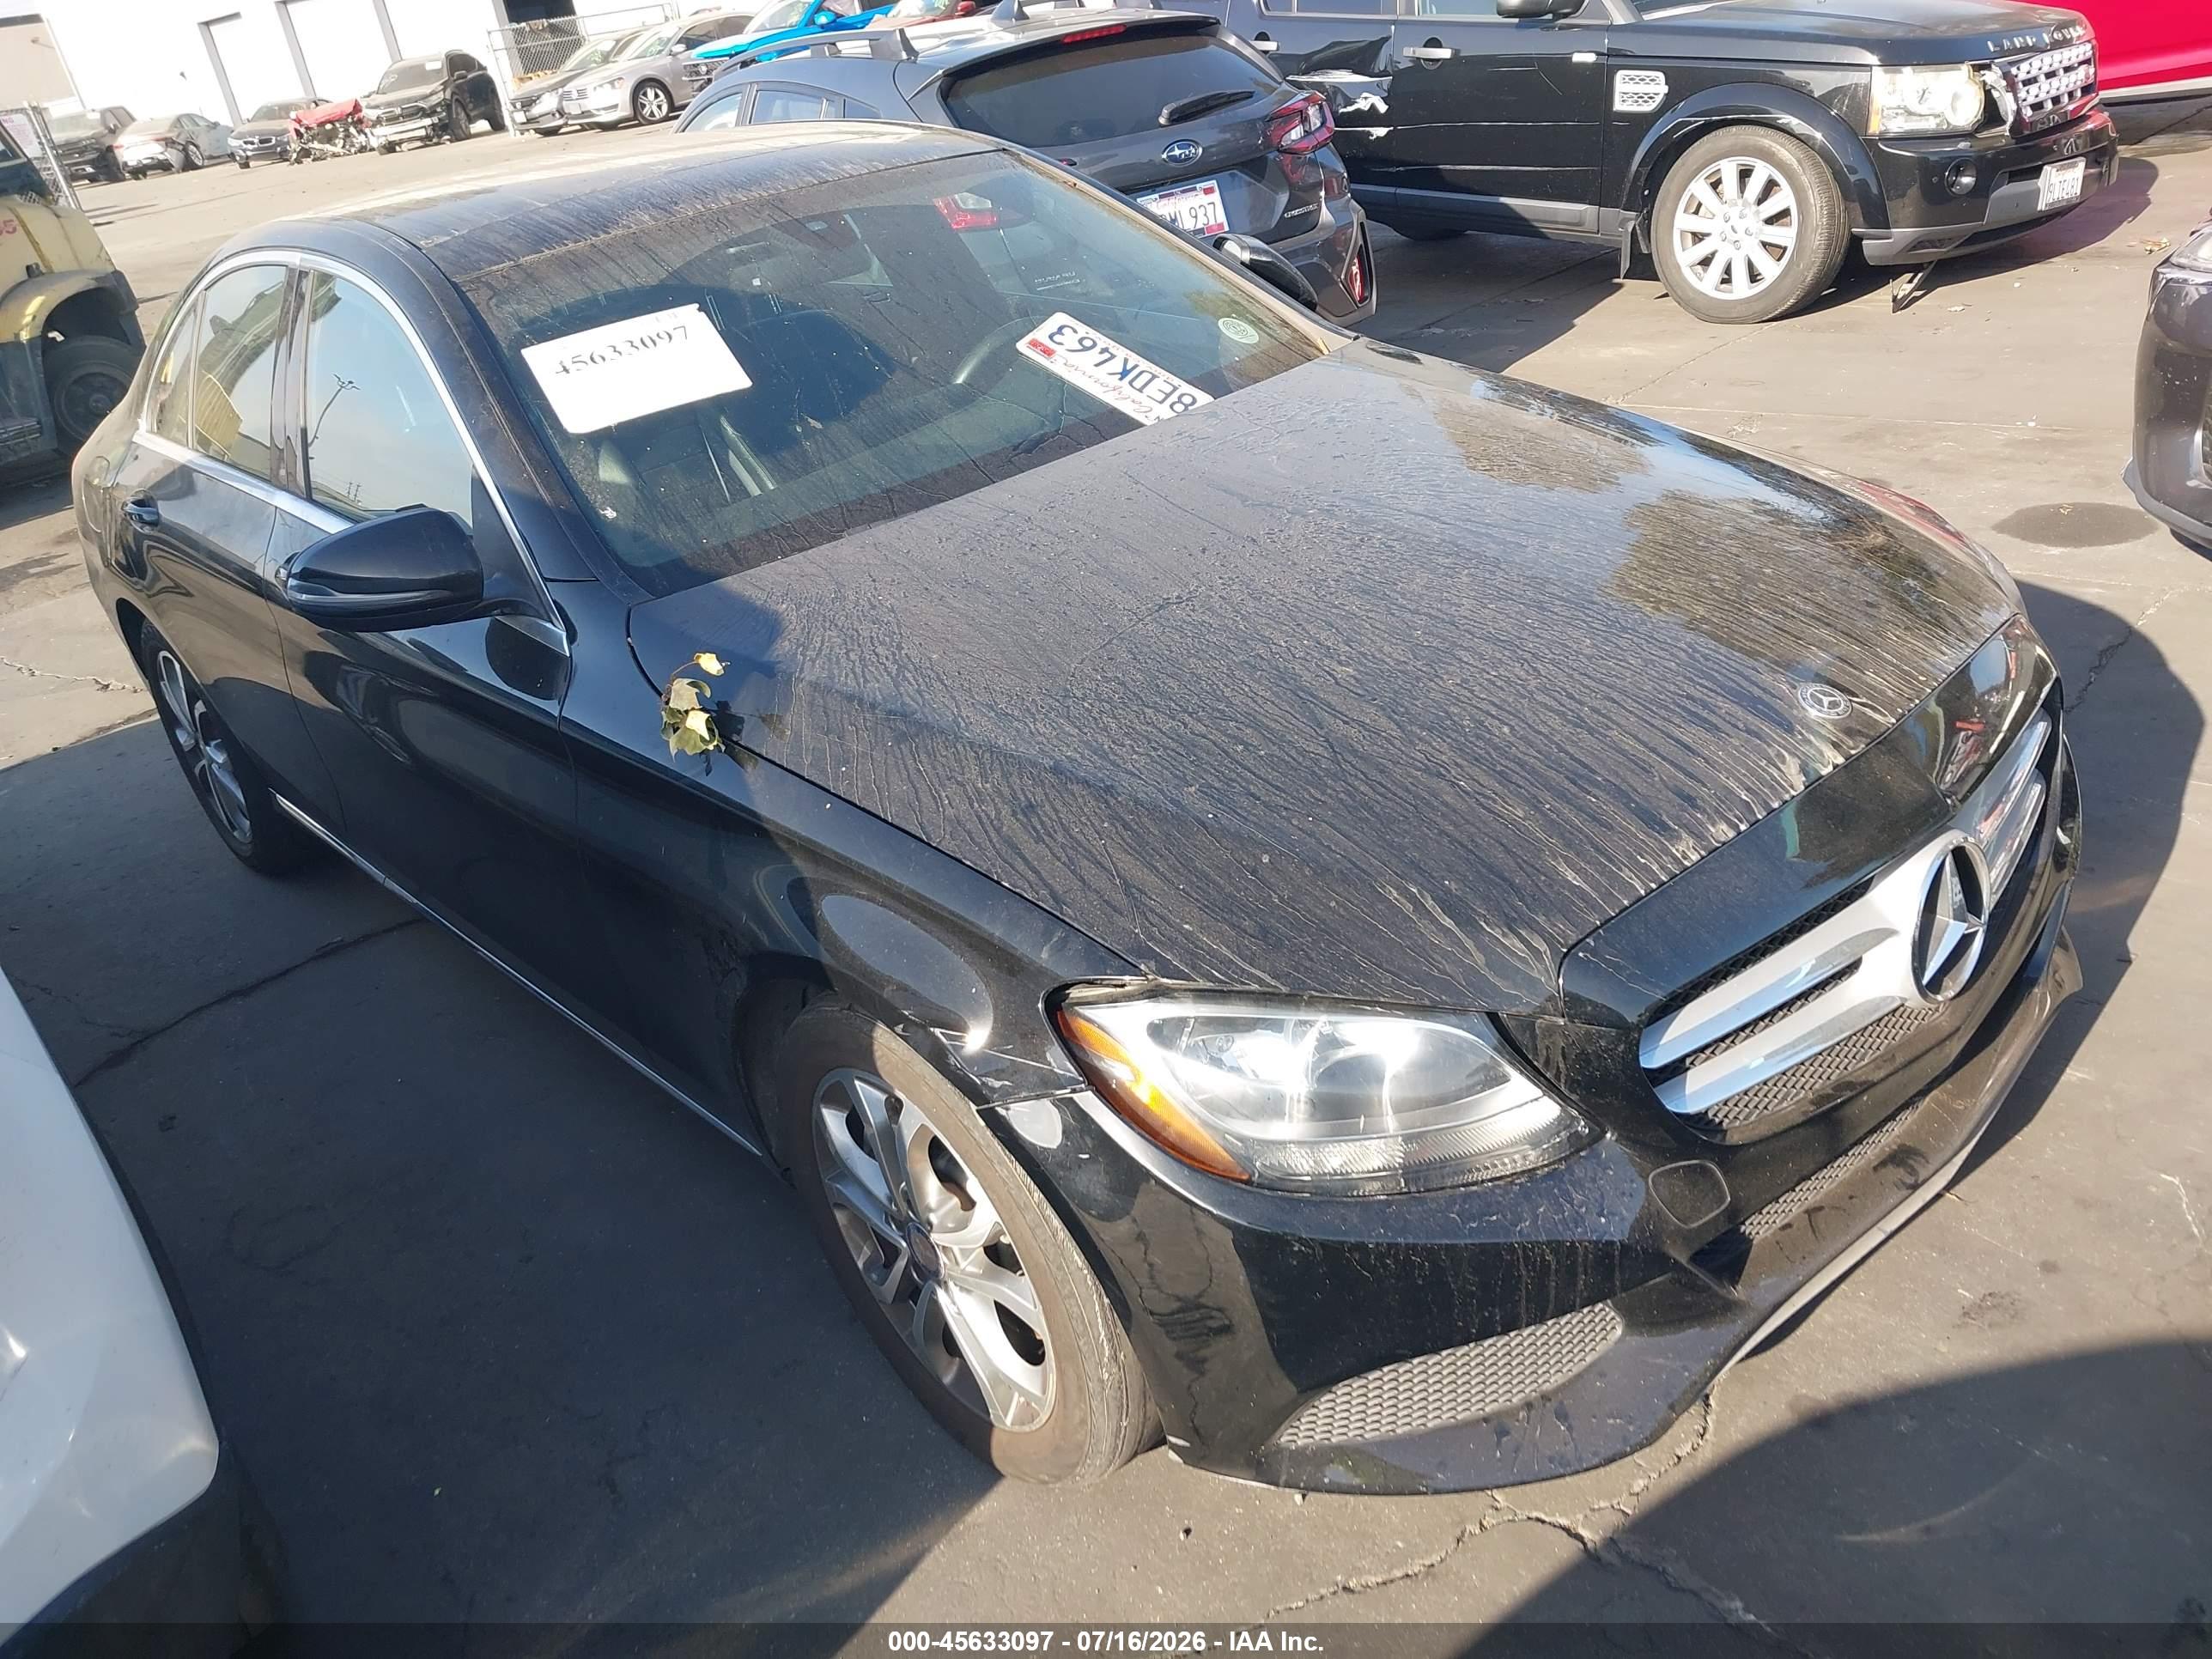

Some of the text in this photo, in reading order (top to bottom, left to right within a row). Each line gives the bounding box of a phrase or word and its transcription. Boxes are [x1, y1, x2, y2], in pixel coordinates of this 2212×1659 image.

[1987, 35, 2036, 52] LAND
[556, 325, 688, 374] 45633097
[1048, 324, 1198, 415] 8EDK463
